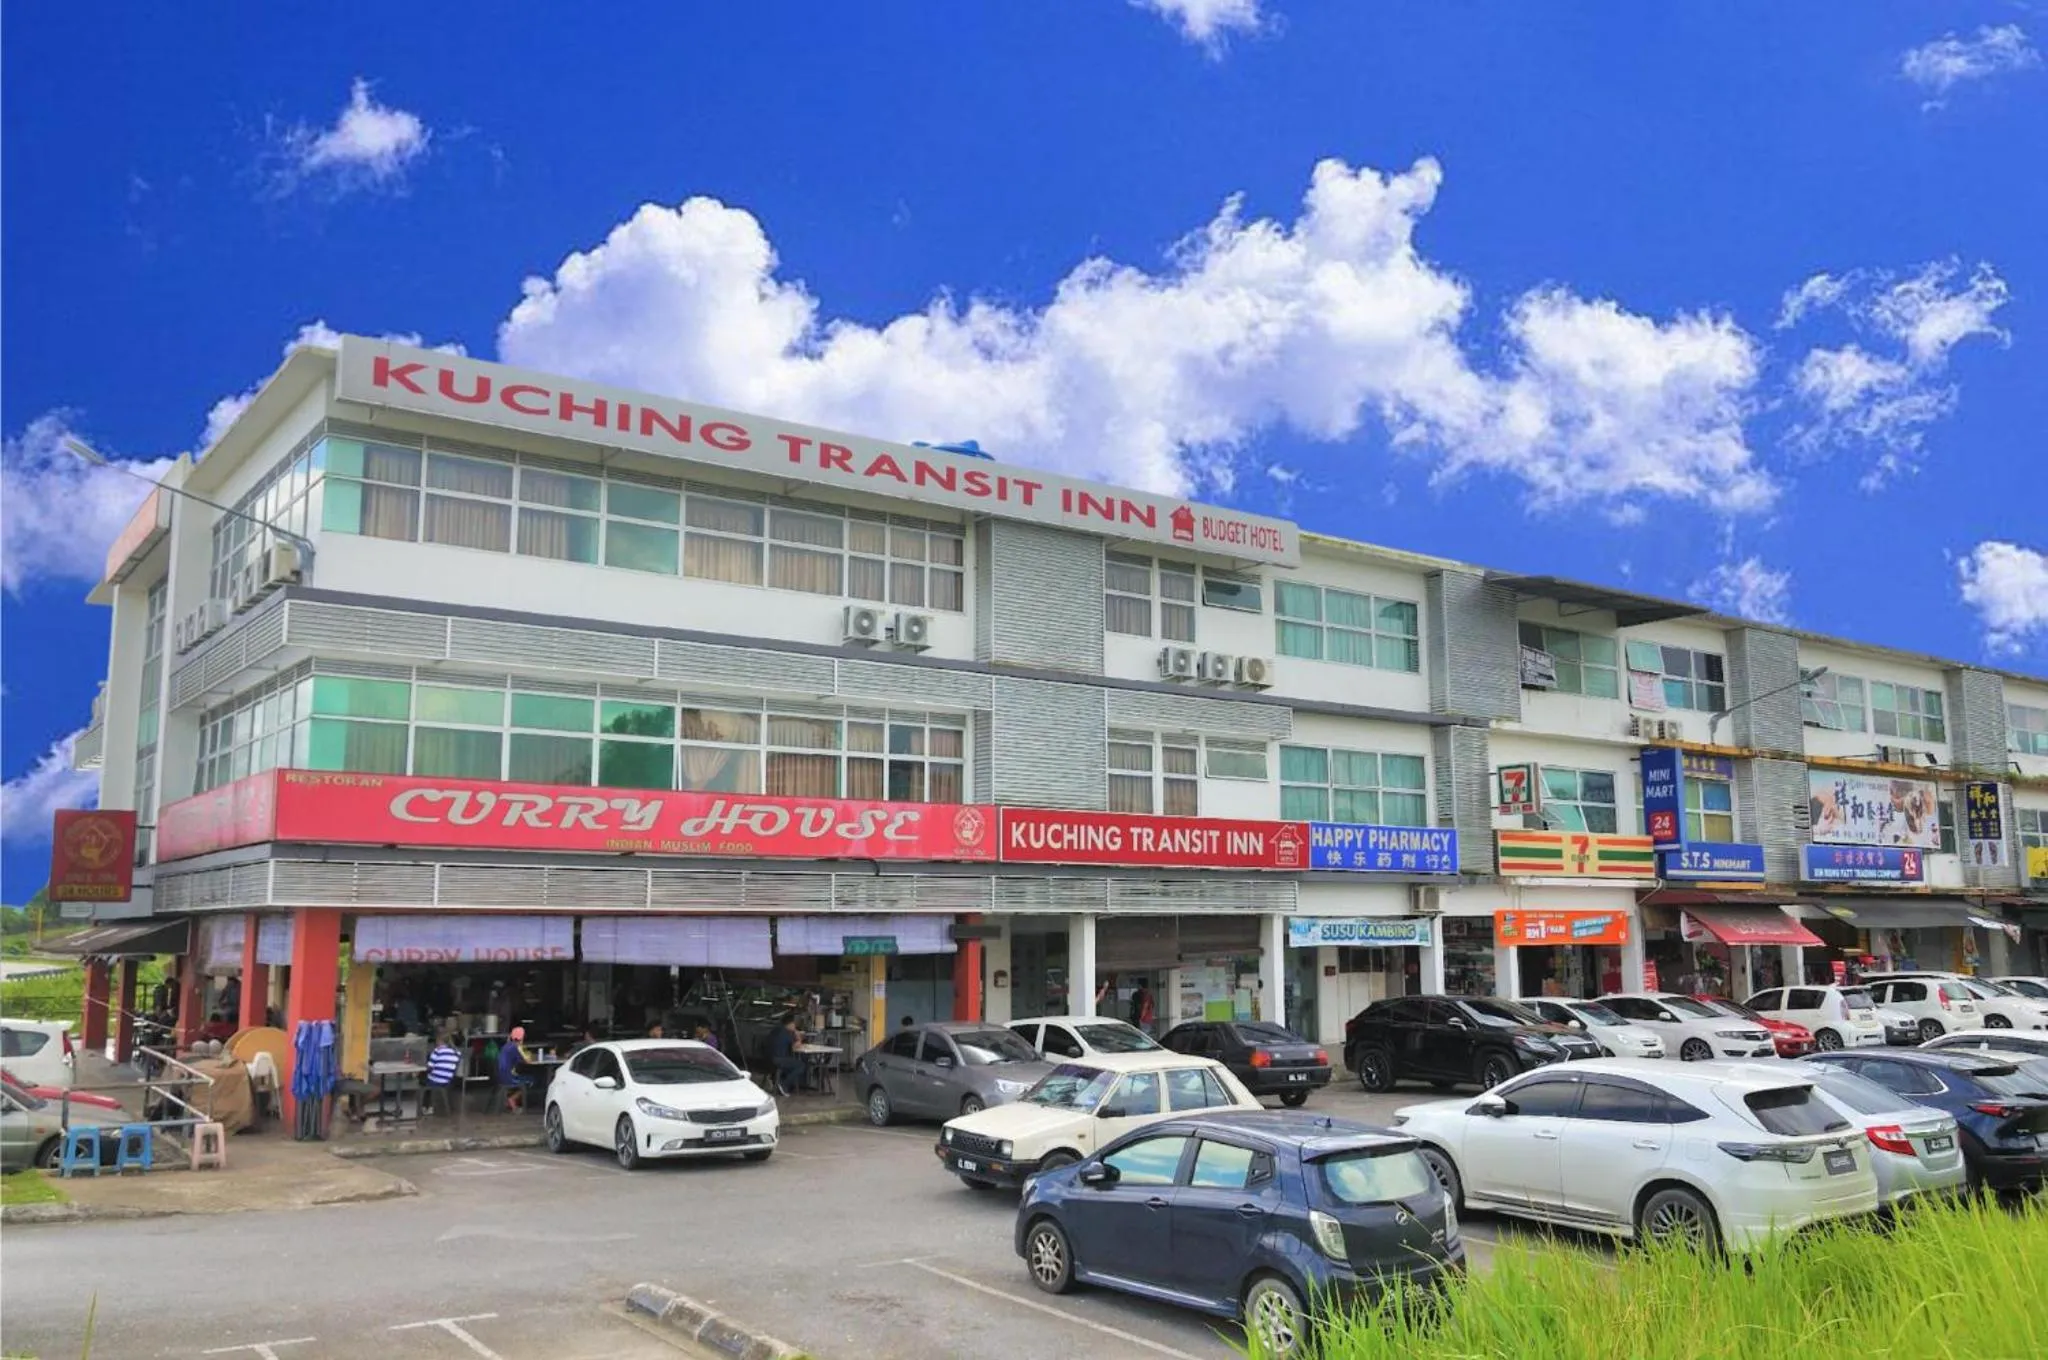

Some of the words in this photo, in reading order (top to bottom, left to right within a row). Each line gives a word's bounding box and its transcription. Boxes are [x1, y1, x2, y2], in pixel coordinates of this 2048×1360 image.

[373, 356, 752, 452] KUCHING
[777, 433, 1042, 507] TRANSIT
[1062, 488, 1157, 529] INN
[1202, 516, 1247, 545] BUDGET
[1250, 525, 1285, 553] HOTEL
[285, 773, 384, 788] RESTORAN
[1648, 768, 1671, 781] MINI
[1646, 784, 1674, 798] MART
[389, 788, 664, 832] CURRY
[680, 799, 921, 840] HOUSE
[1654, 815, 1670, 829] 24
[606, 838, 653, 850] INDIAN
[719, 842, 753, 853] FOOD
[1011, 822, 1123, 851] KUCHING
[1130, 827, 1220, 854] TRANSIT
[1227, 831, 1264, 856] INN
[1311, 827, 1364, 849] HAPPY
[1368, 830, 1449, 852] PHARMACY
[1321, 923, 1356, 939] SUSU
[1358, 923, 1416, 939] KAMBING
